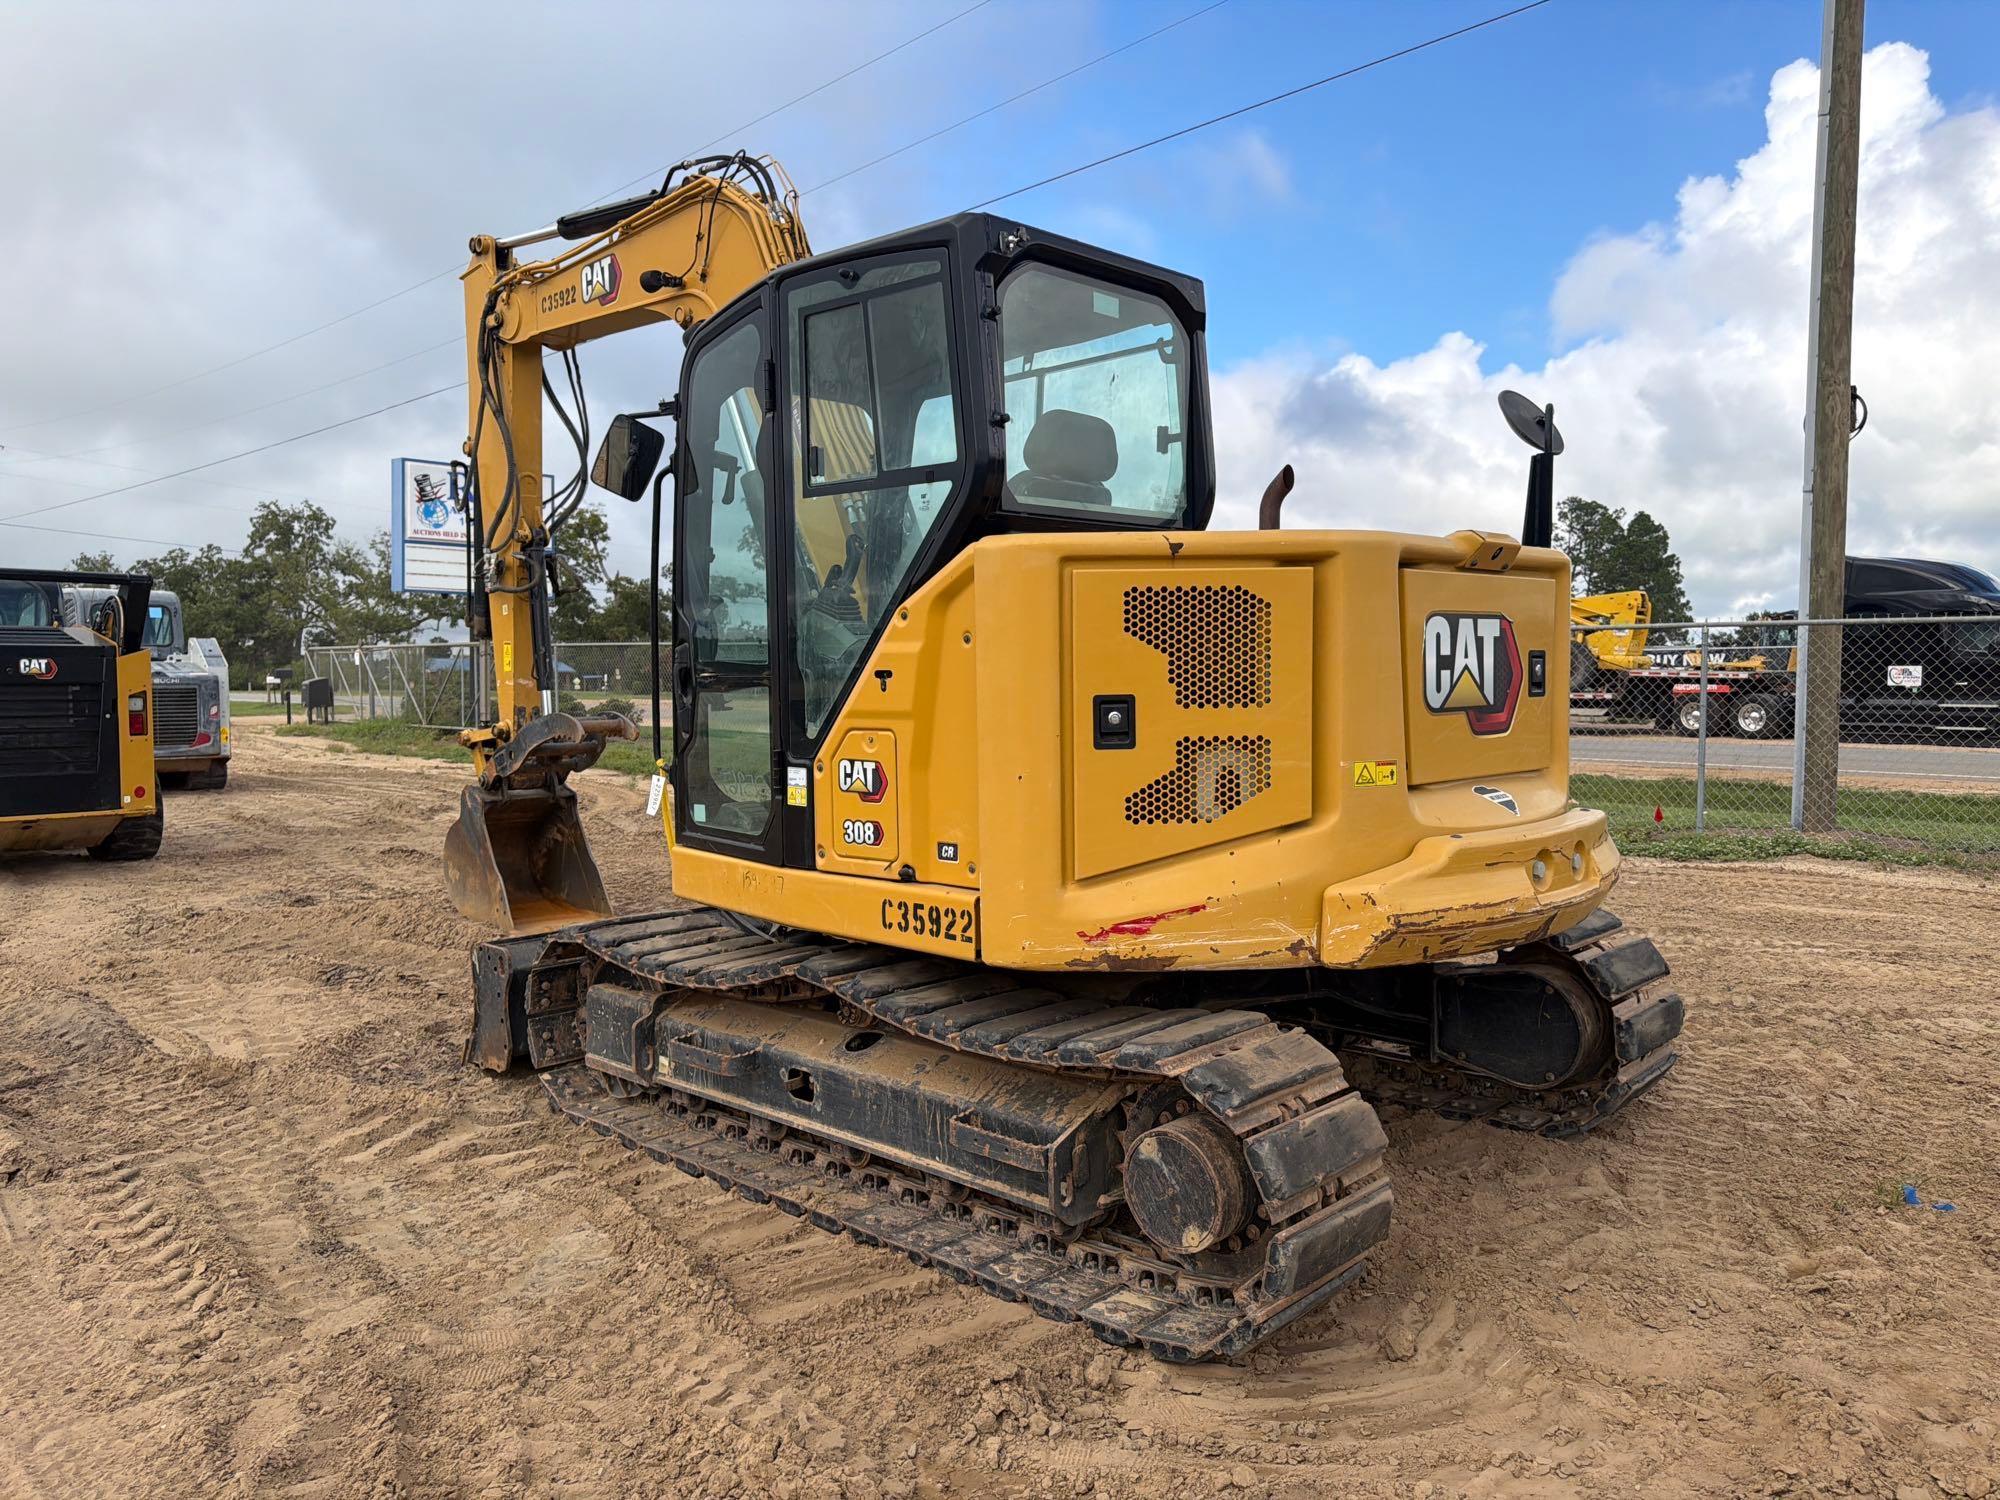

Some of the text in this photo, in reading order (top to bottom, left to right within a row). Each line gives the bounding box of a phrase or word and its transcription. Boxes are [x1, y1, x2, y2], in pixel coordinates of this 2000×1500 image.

[581, 255, 613, 303] CAT
[541, 284, 577, 314] C35922
[413, 529, 441, 537] AUCTIONS
[19, 658, 48, 674] CAT
[1425, 615, 1501, 709] CAT
[1646, 652, 1726, 667] BUY NW
[839, 759, 876, 793] CAT
[843, 820, 875, 845] 308
[941, 845, 954, 858] CR
[881, 898, 973, 944] C35922
